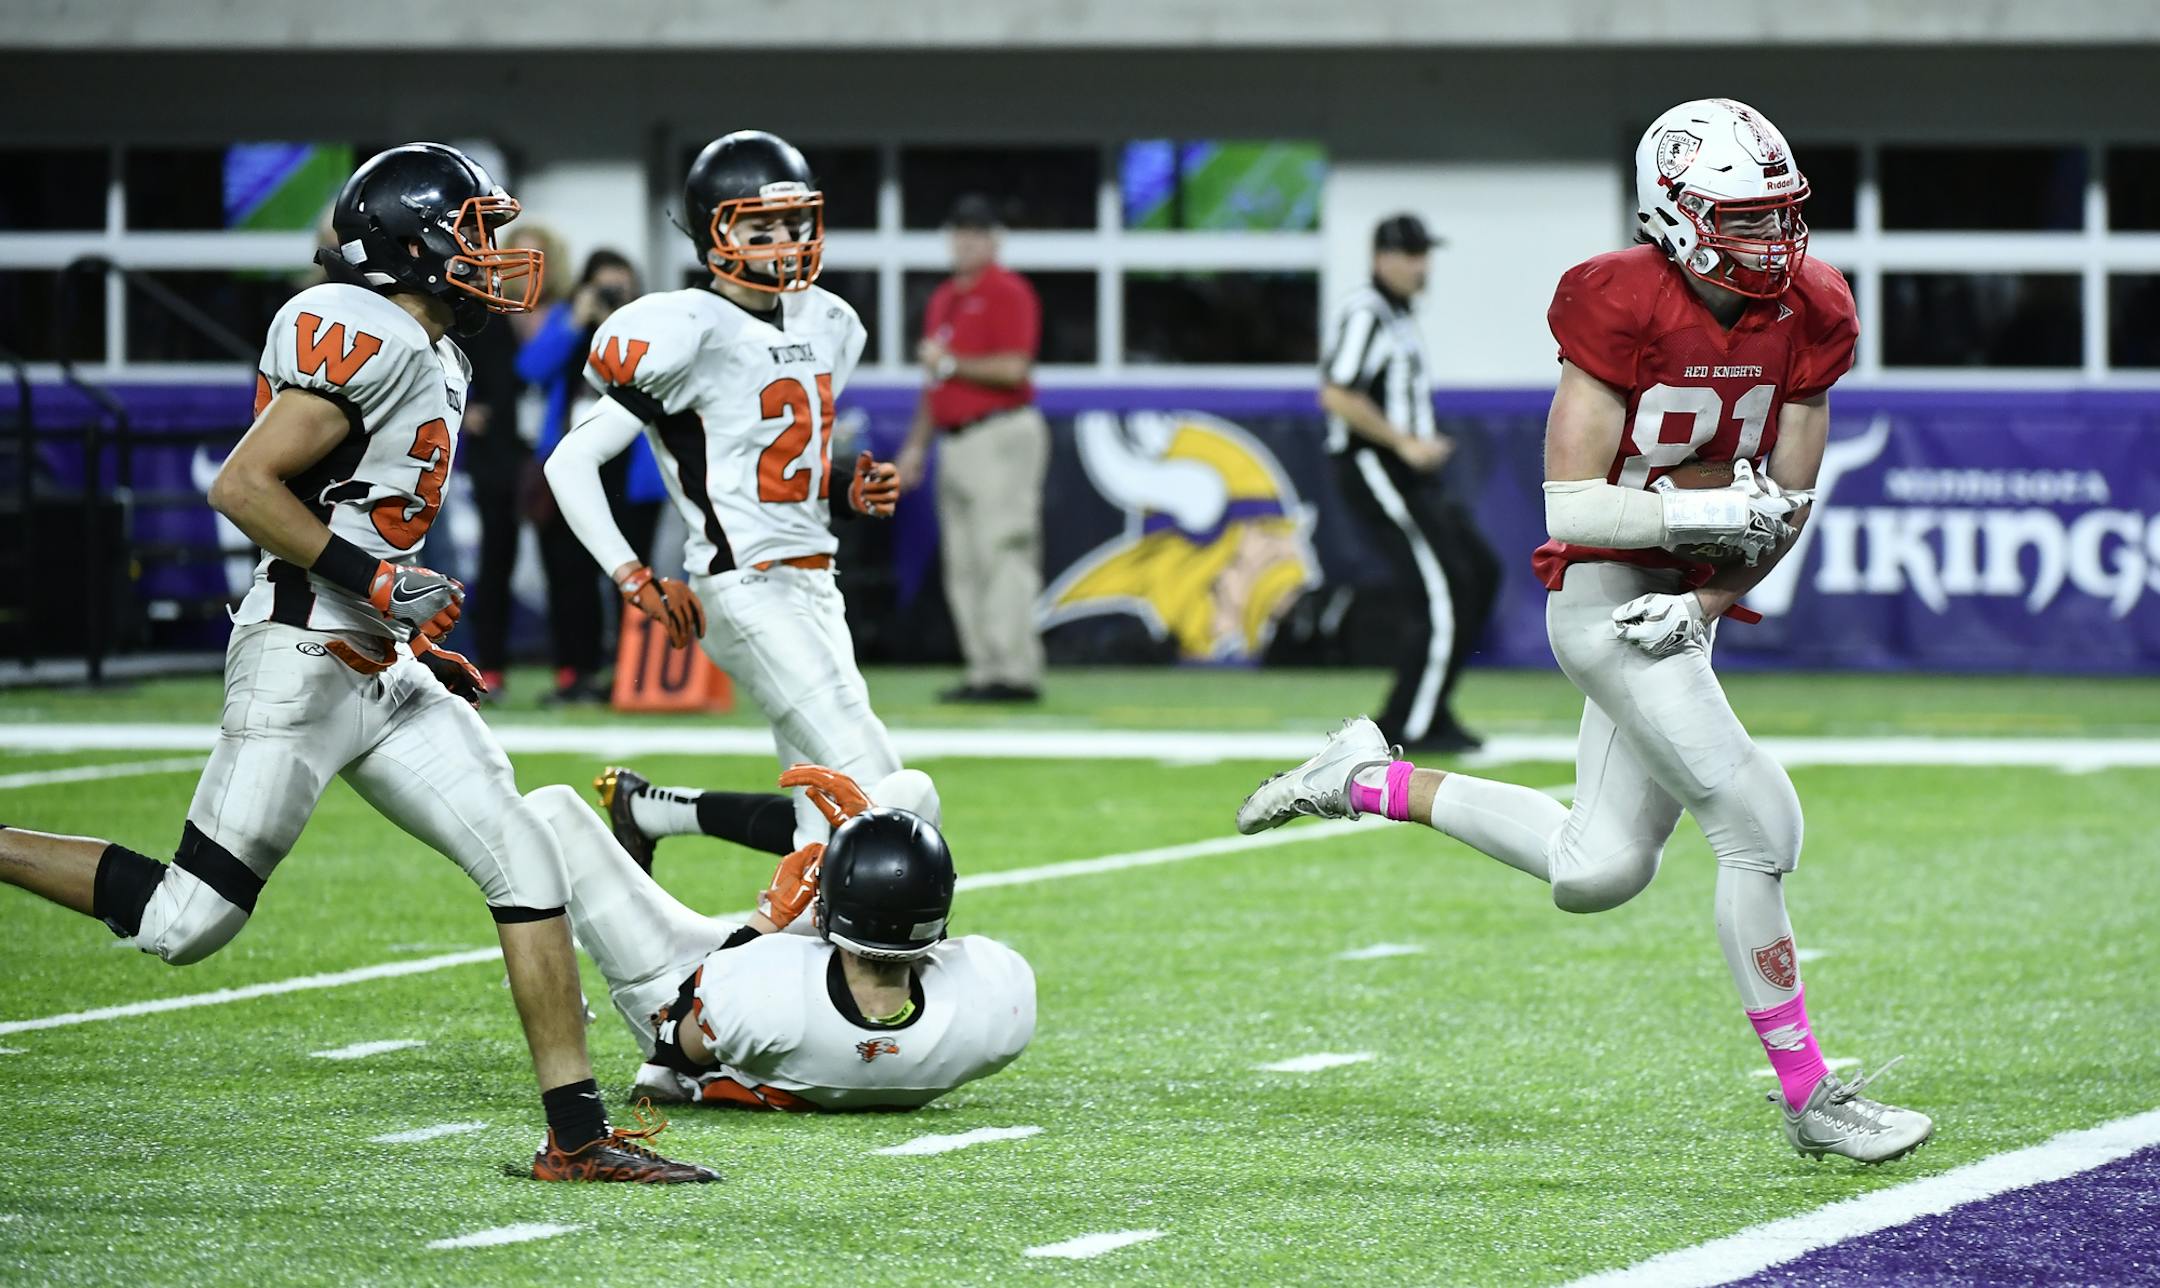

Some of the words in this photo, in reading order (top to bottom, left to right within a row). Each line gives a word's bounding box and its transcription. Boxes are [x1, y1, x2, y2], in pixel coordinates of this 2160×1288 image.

[294, 311, 383, 387] W
[1684, 365, 1709, 378] RED
[1712, 364, 1763, 379] KNIGHTS
[757, 373, 835, 504] 21
[1616, 382, 1777, 490] 81
[1742, 412, 2160, 621] VIKING
[633, 618, 695, 694] 10
